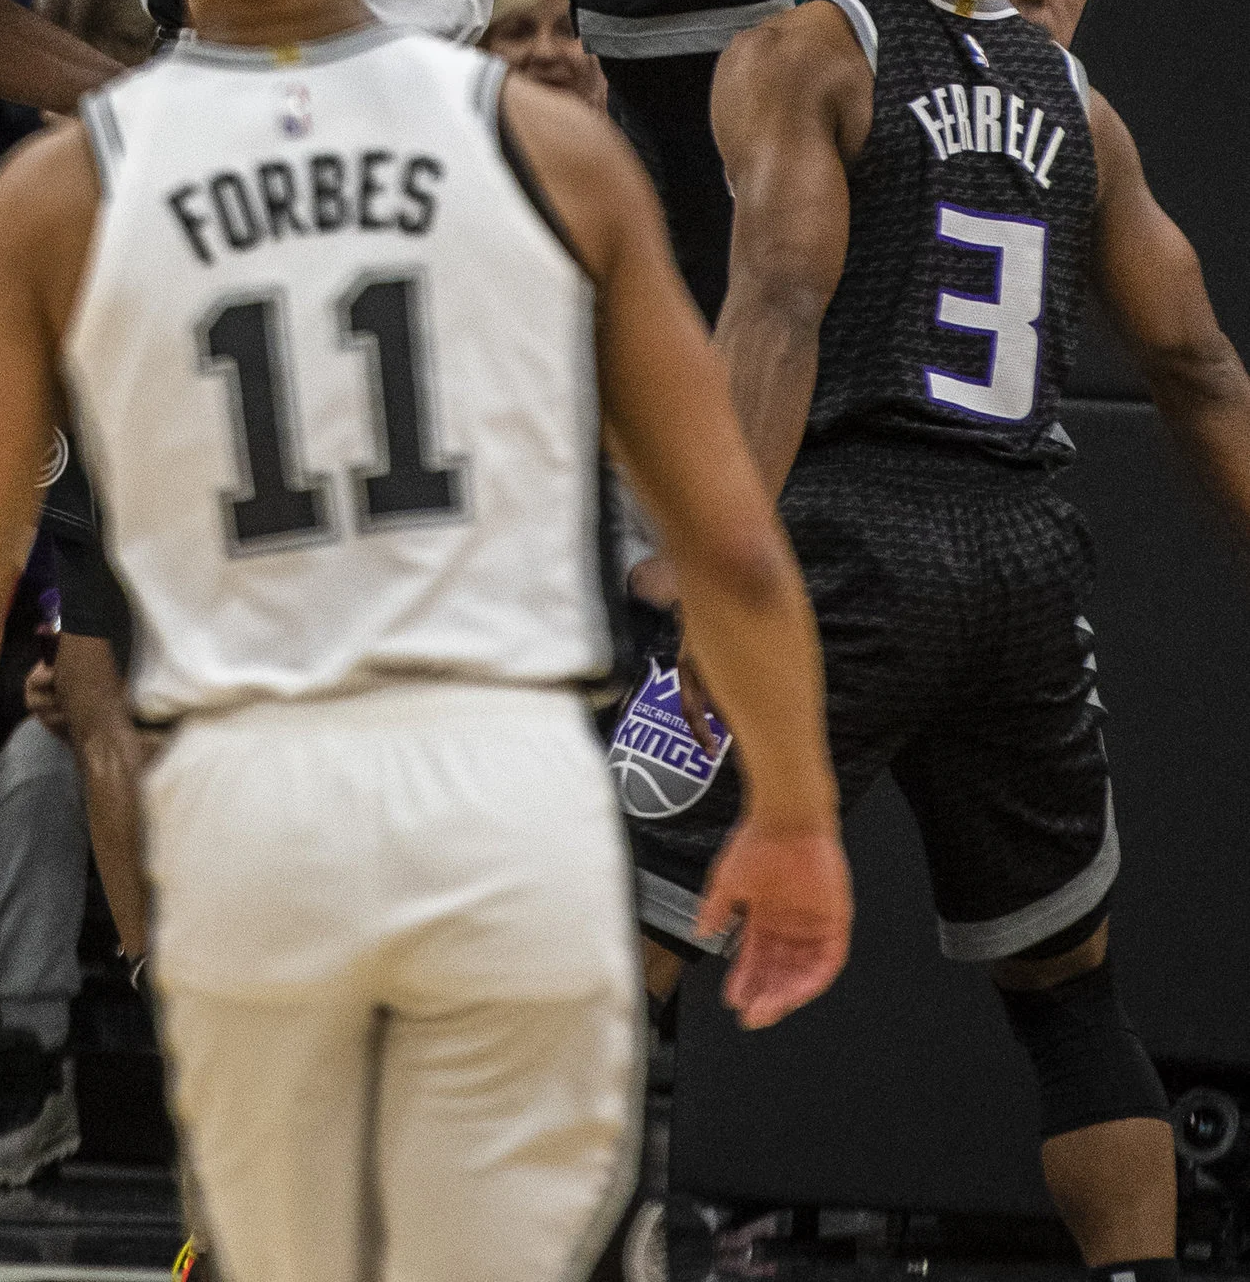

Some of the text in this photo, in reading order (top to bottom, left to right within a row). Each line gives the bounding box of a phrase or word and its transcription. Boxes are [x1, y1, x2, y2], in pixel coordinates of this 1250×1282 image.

[908, 84, 1065, 189] FERRELL
[166, 147, 445, 267] FORBES
[923, 201, 1050, 423] 3
[191, 263, 475, 560] 11
[616, 719, 714, 782] KINGS
